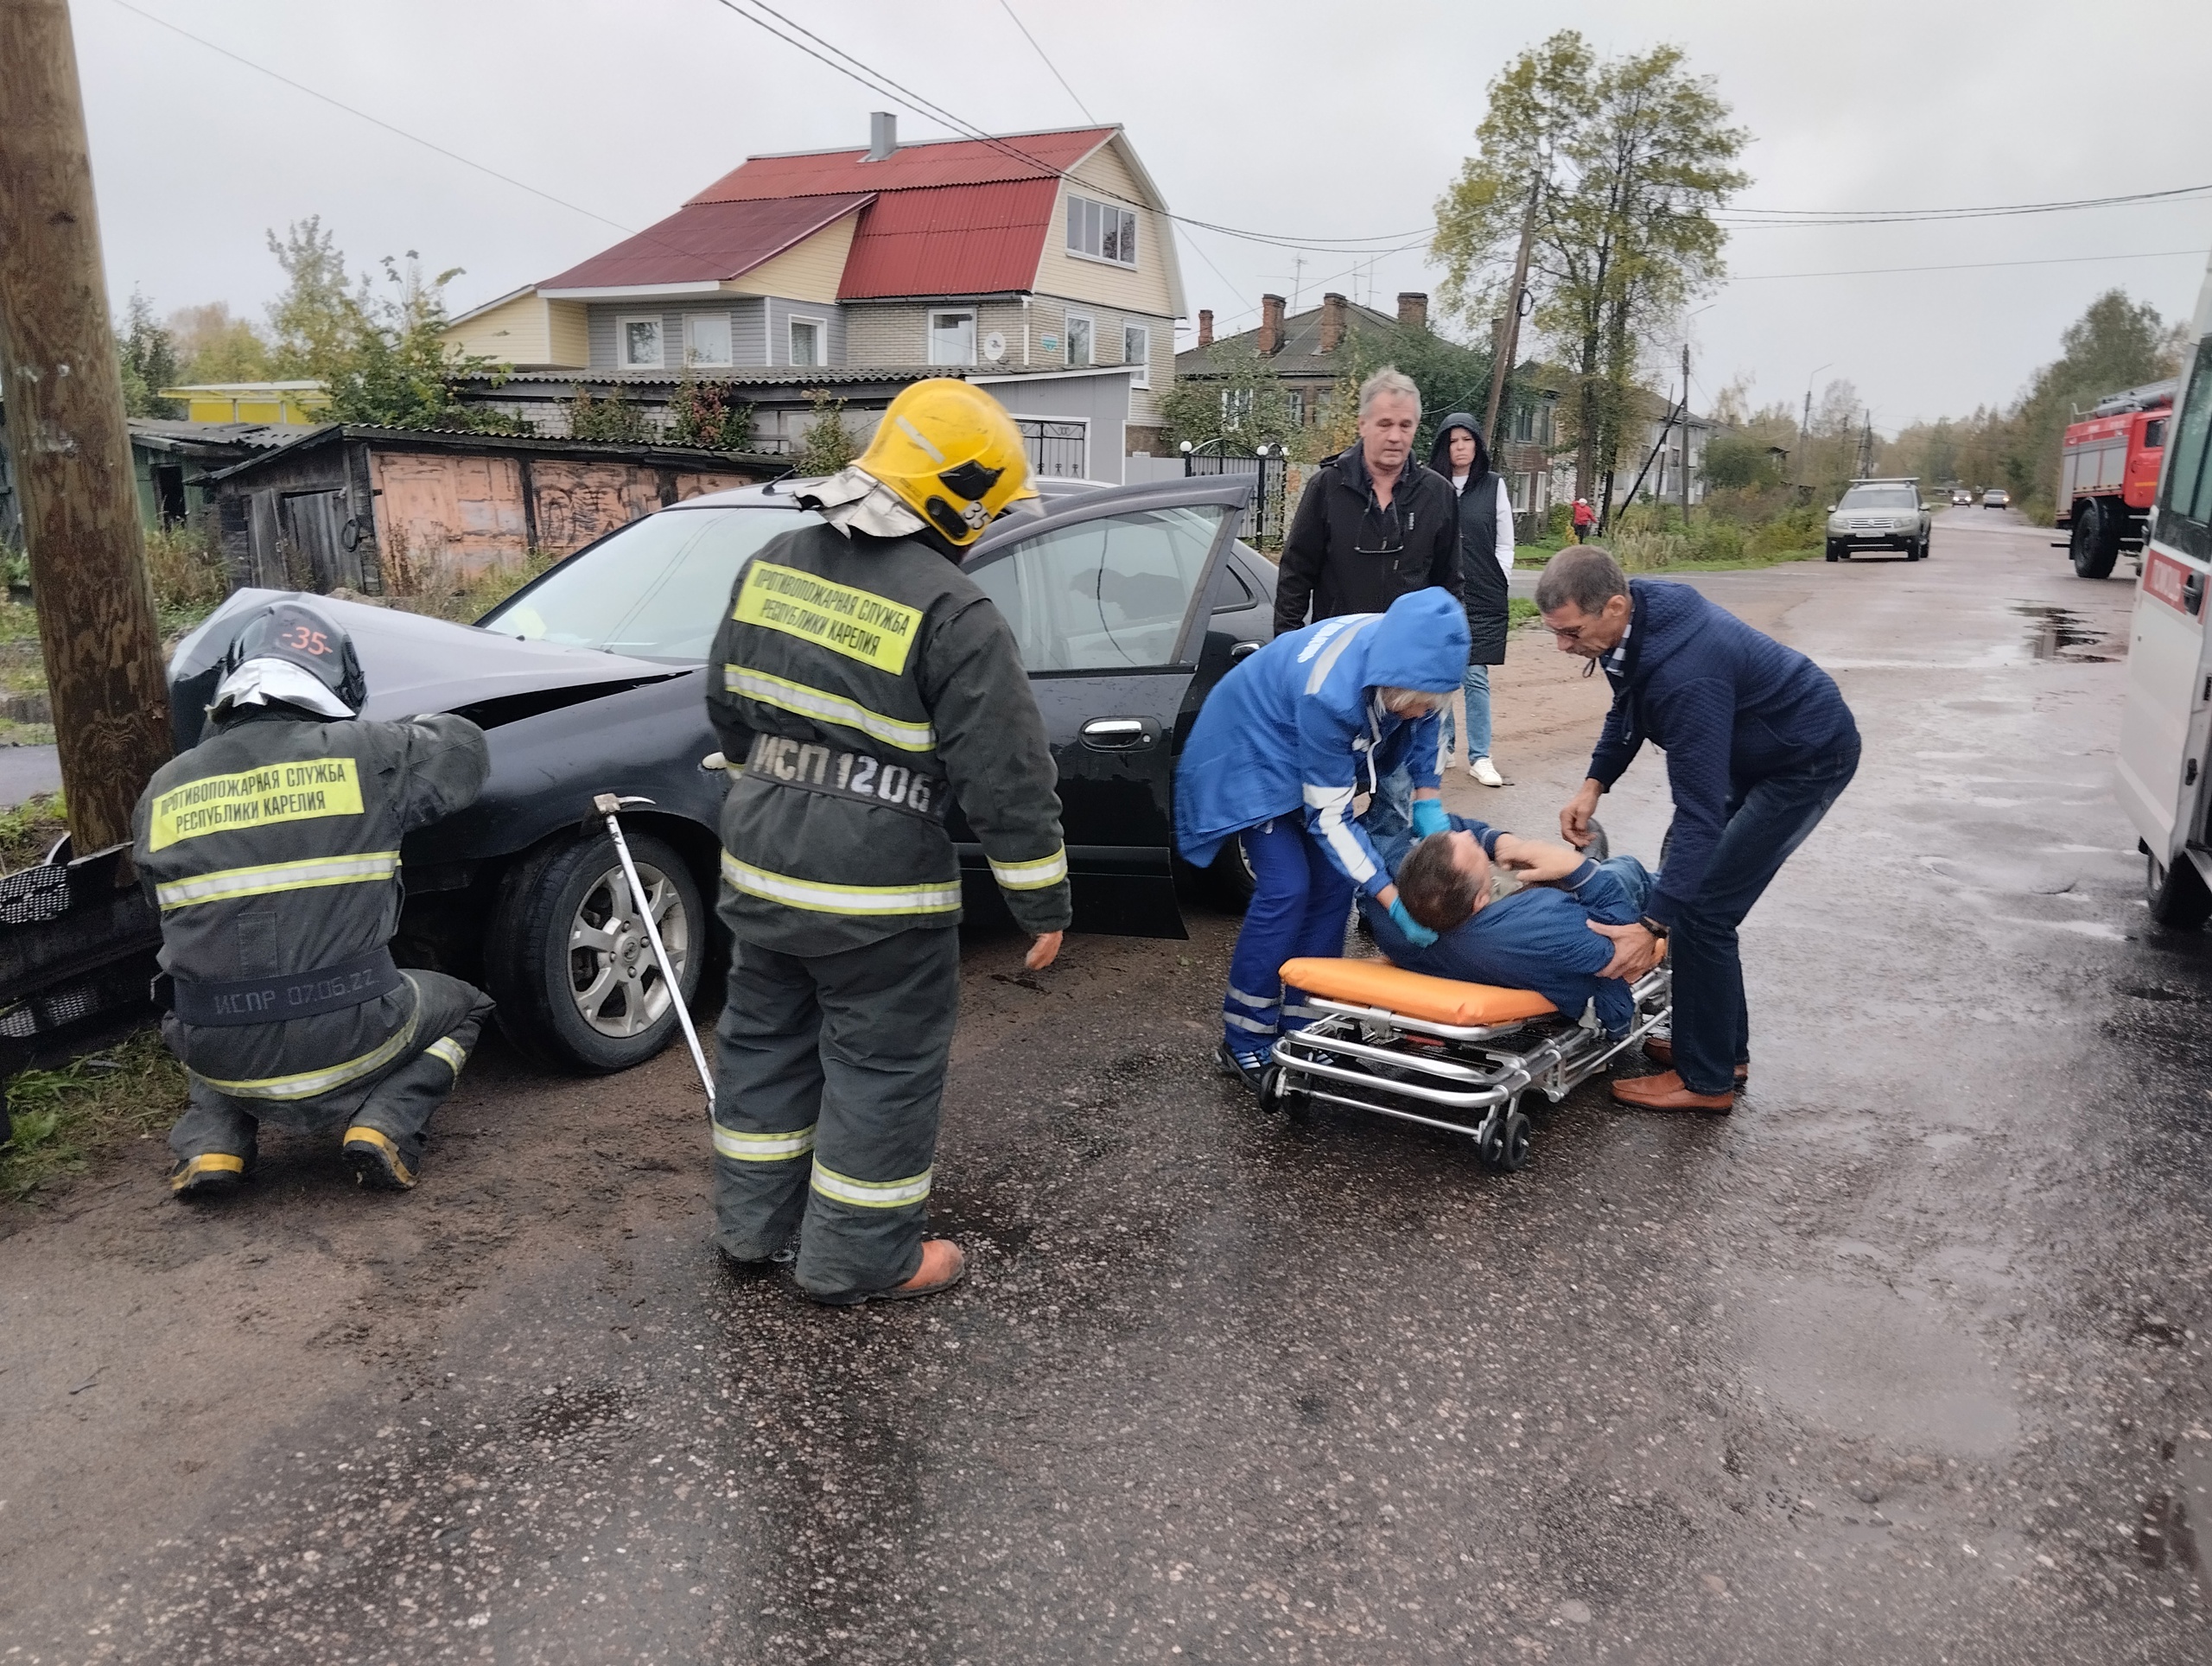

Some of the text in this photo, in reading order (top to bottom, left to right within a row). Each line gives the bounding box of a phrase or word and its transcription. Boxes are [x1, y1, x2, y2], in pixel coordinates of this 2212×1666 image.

[963, 501, 993, 530] 35
[753, 569, 911, 637] ПРОТИВОПОЖАРНАЯ СЛУЖБА
[760, 598, 881, 658] РЕСПУБЛИКИ КАРЕЛИЯ
[753, 734, 830, 785] ИСП
[161, 763, 346, 817] ПРОТИВОПОЖАРНАЯ СЛУЖБА
[176, 790, 327, 834] РЕСПУБЛИКИ КАРЕЛИЯ
[214, 990, 276, 1014] ИСПР
